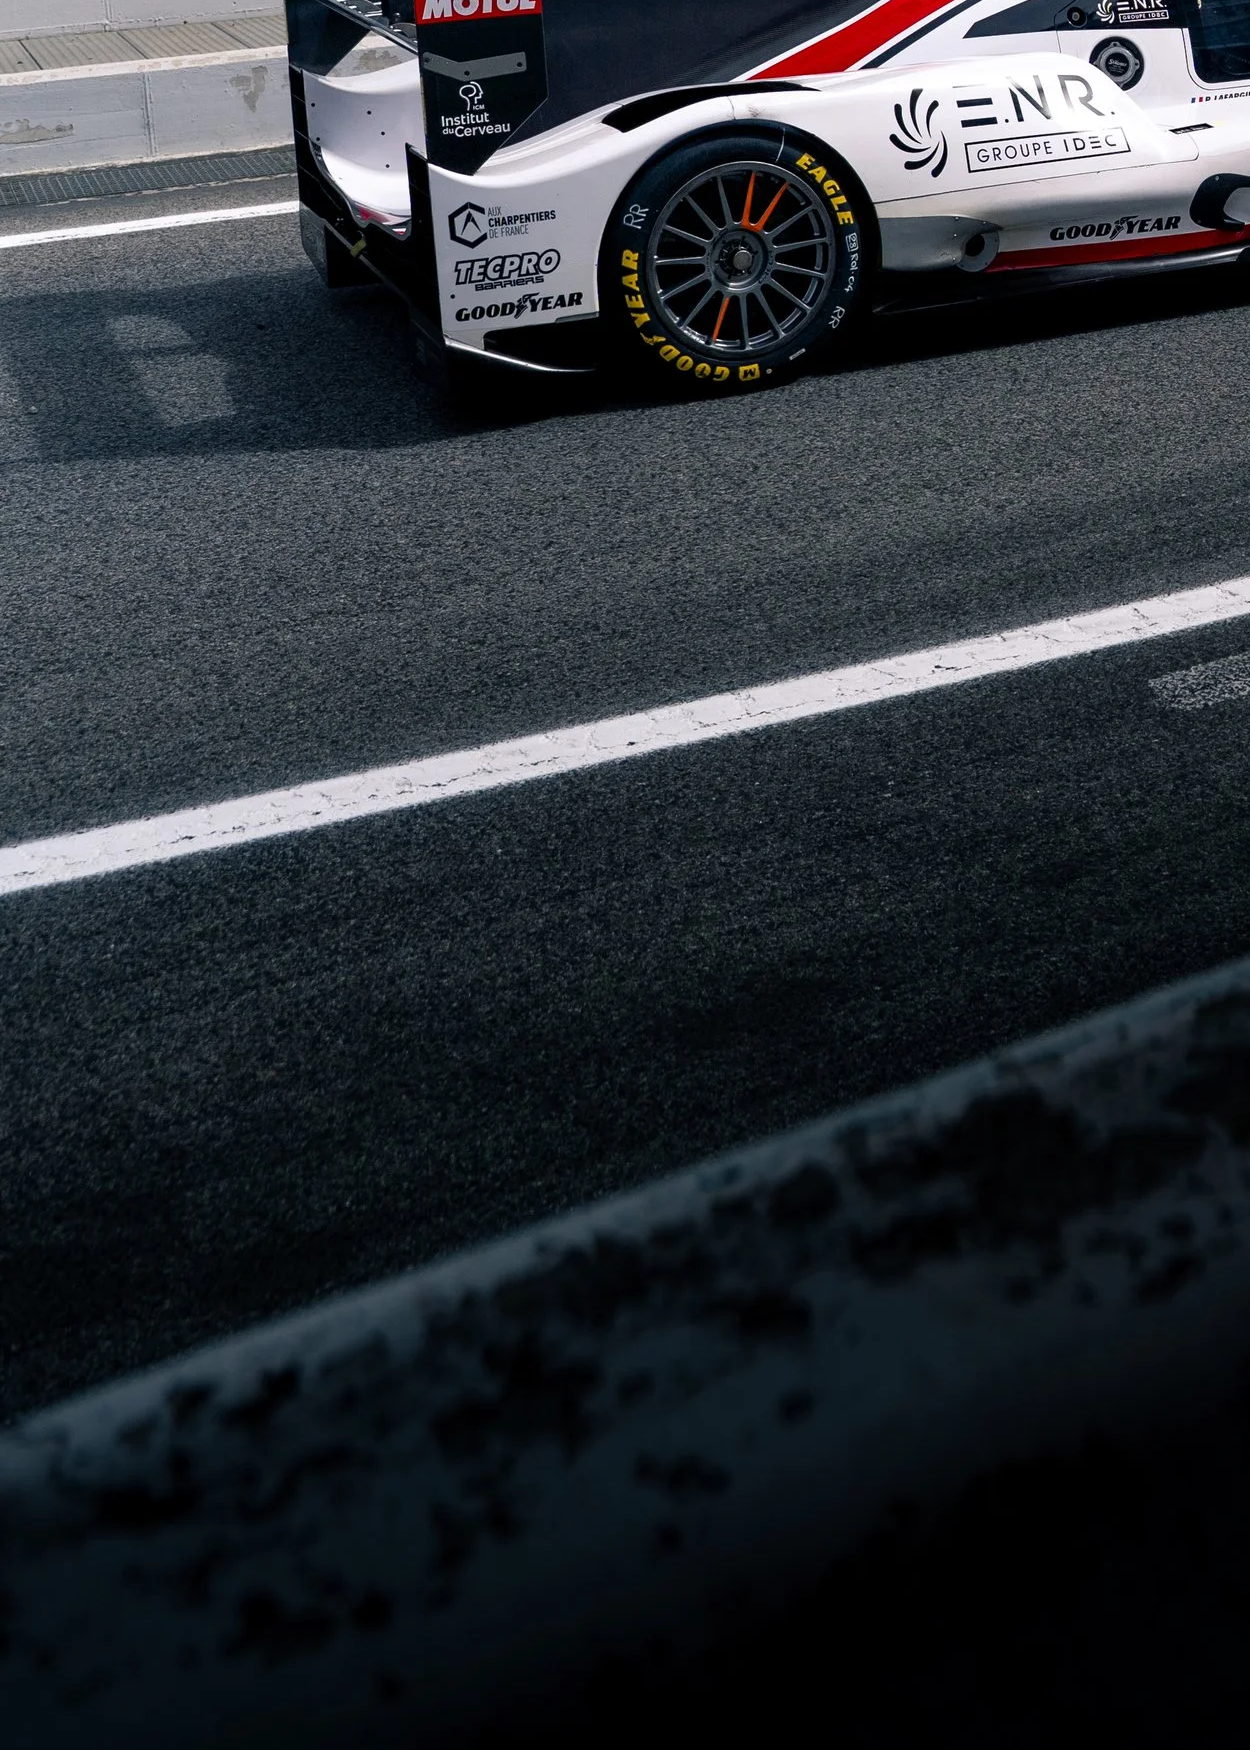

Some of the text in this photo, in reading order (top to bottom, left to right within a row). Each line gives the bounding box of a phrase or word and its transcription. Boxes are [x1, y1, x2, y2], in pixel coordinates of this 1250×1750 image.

[1122, 12, 1146, 21] GROUPE
[1148, 11, 1166, 19] IDEC
[441, 112, 490, 128] Institut
[442, 123, 511, 138] du Cerveau
[977, 141, 1053, 163] GROUPE
[1063, 134, 1117, 153] IDEC
[796, 153, 854, 225] EAGLE
[487, 206, 502, 217] AUX
[488, 210, 556, 228] CHARPENTIERS
[623, 204, 649, 229] RR
[488, 224, 529, 239] DE FRANCE
[1050, 215, 1182, 240] GOODYEAR
[454, 248, 561, 285] TECPRO
[455, 292, 584, 322] GOODYEAR
[828, 305, 846, 329] RR
